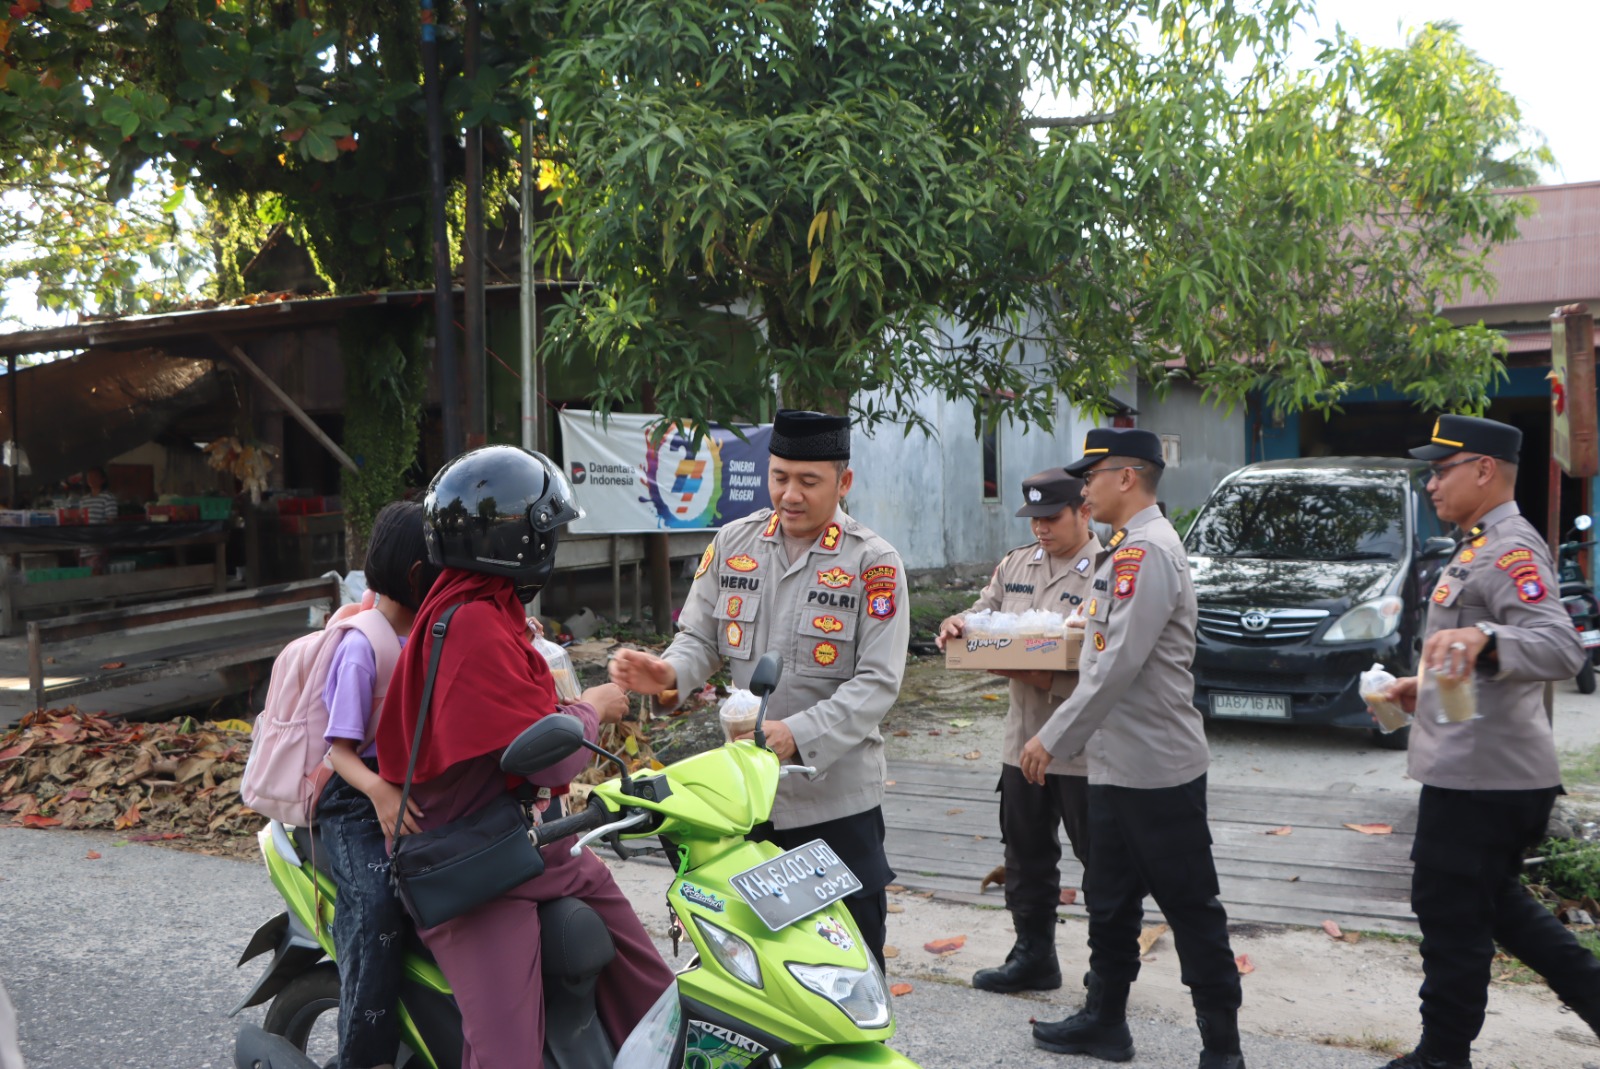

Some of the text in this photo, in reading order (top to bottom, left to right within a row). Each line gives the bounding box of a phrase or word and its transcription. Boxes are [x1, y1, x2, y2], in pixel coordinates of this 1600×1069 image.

[590, 462, 635, 474] Danantara
[729, 460, 755, 472] SINERGI
[590, 475, 633, 486] Indonesia
[729, 474, 761, 487] MAJUKAN
[729, 488, 754, 501] NEGERI
[721, 575, 759, 590] HERU
[808, 591, 855, 608] POLRI
[1267, 697, 1284, 711] AN
[738, 872, 773, 900] KH
[809, 845, 839, 868] HD
